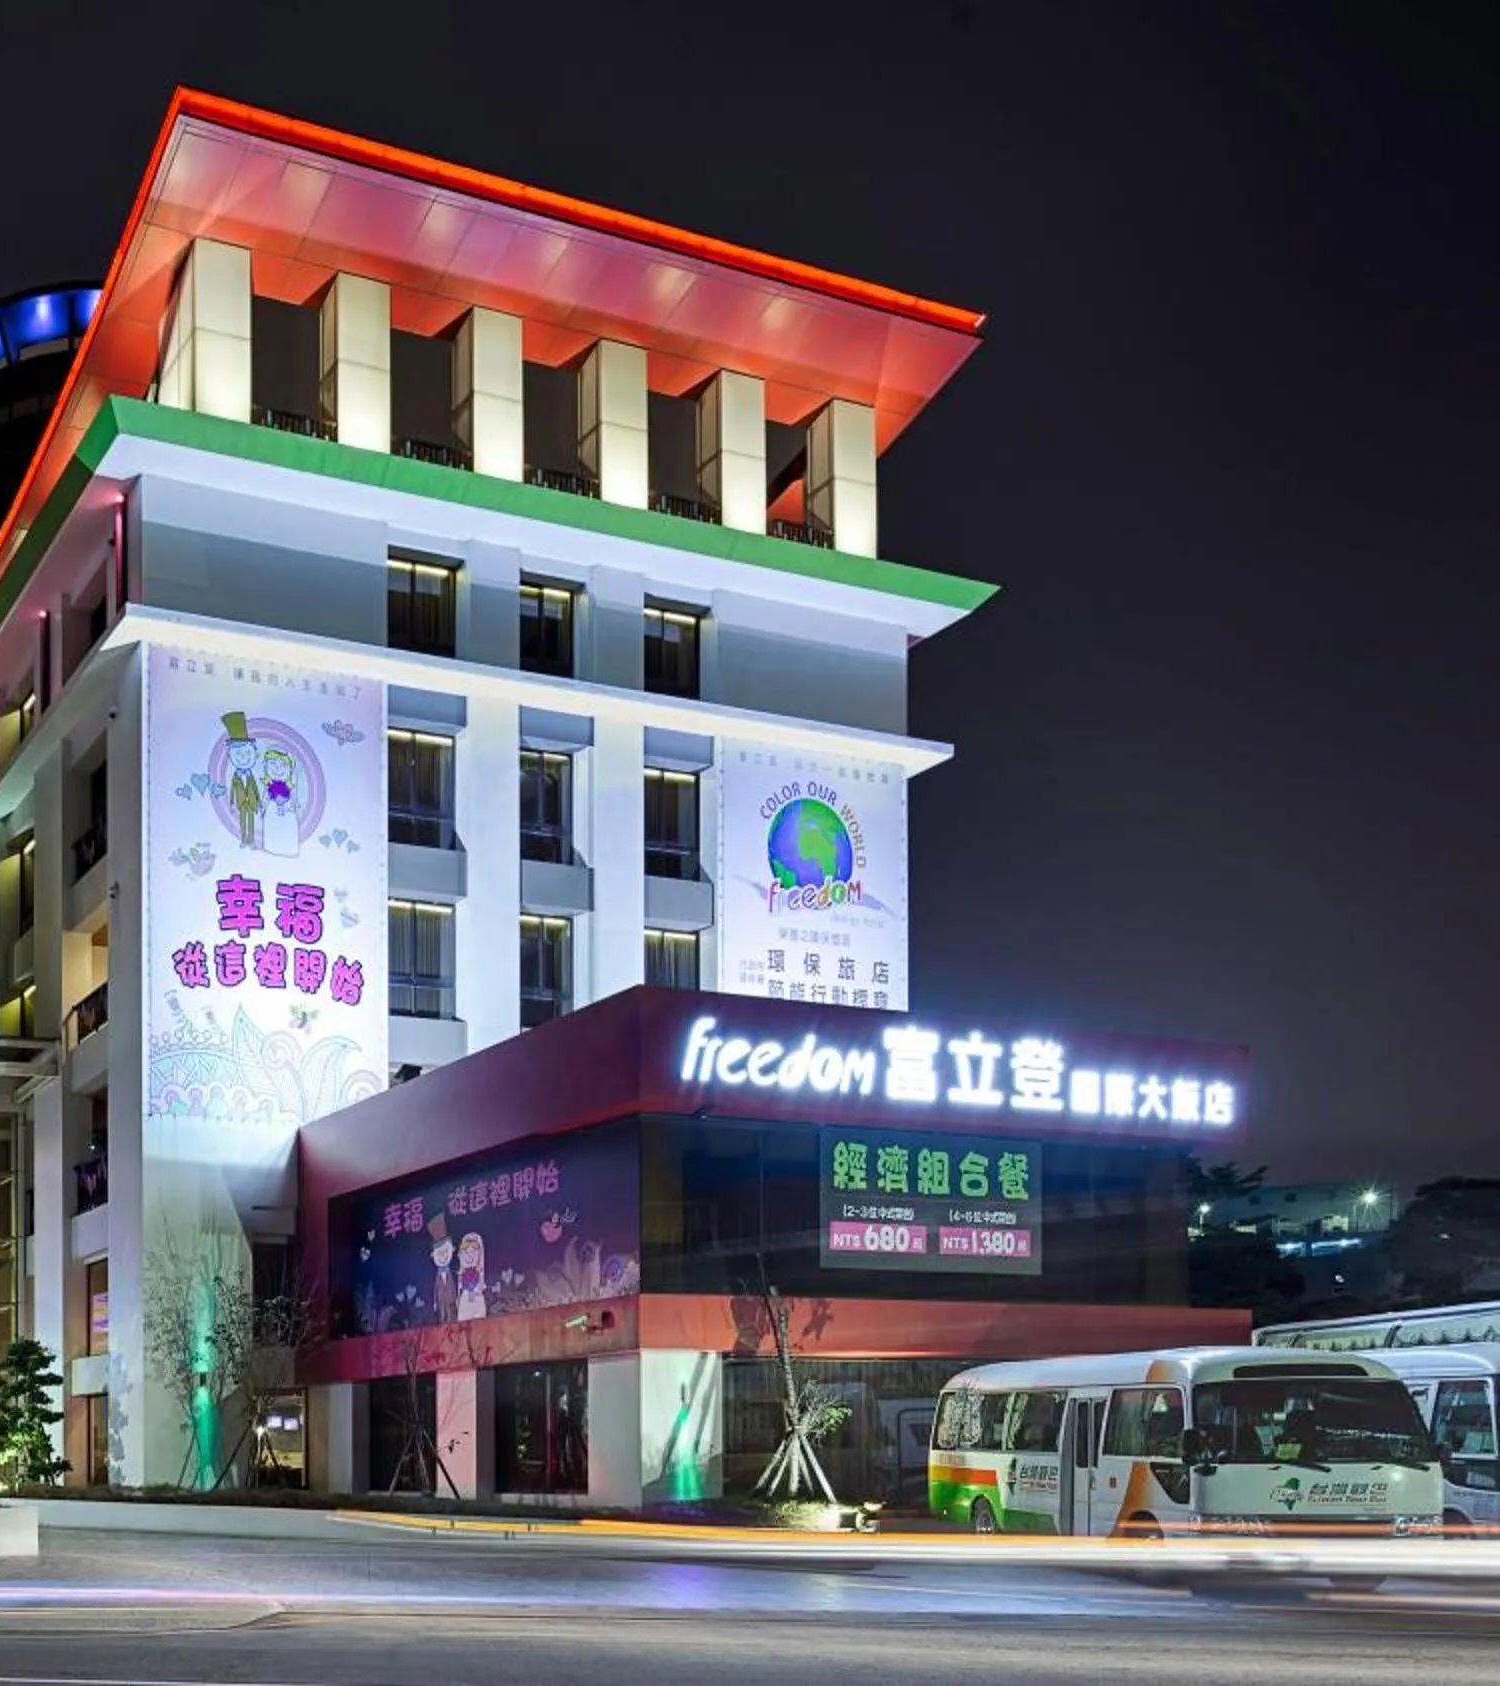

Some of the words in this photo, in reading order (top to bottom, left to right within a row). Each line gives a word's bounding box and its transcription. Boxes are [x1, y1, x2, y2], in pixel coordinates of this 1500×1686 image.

[760, 781, 801, 820] COLOR
[808, 781, 837, 804] OUR
[840, 804, 867, 868] WORLD
[215, 874, 325, 944] 幸福
[172, 940, 366, 1006] 從這裡開始
[768, 949, 889, 984] 環保旅店
[883, 1025, 1065, 1111] 富立登
[384, 1196, 425, 1238] 幸福
[448, 1160, 561, 1216] 從這裡開始
[833, 1141, 1029, 1200] 經濟組合餐
[864, 1224, 910, 1251] 680
